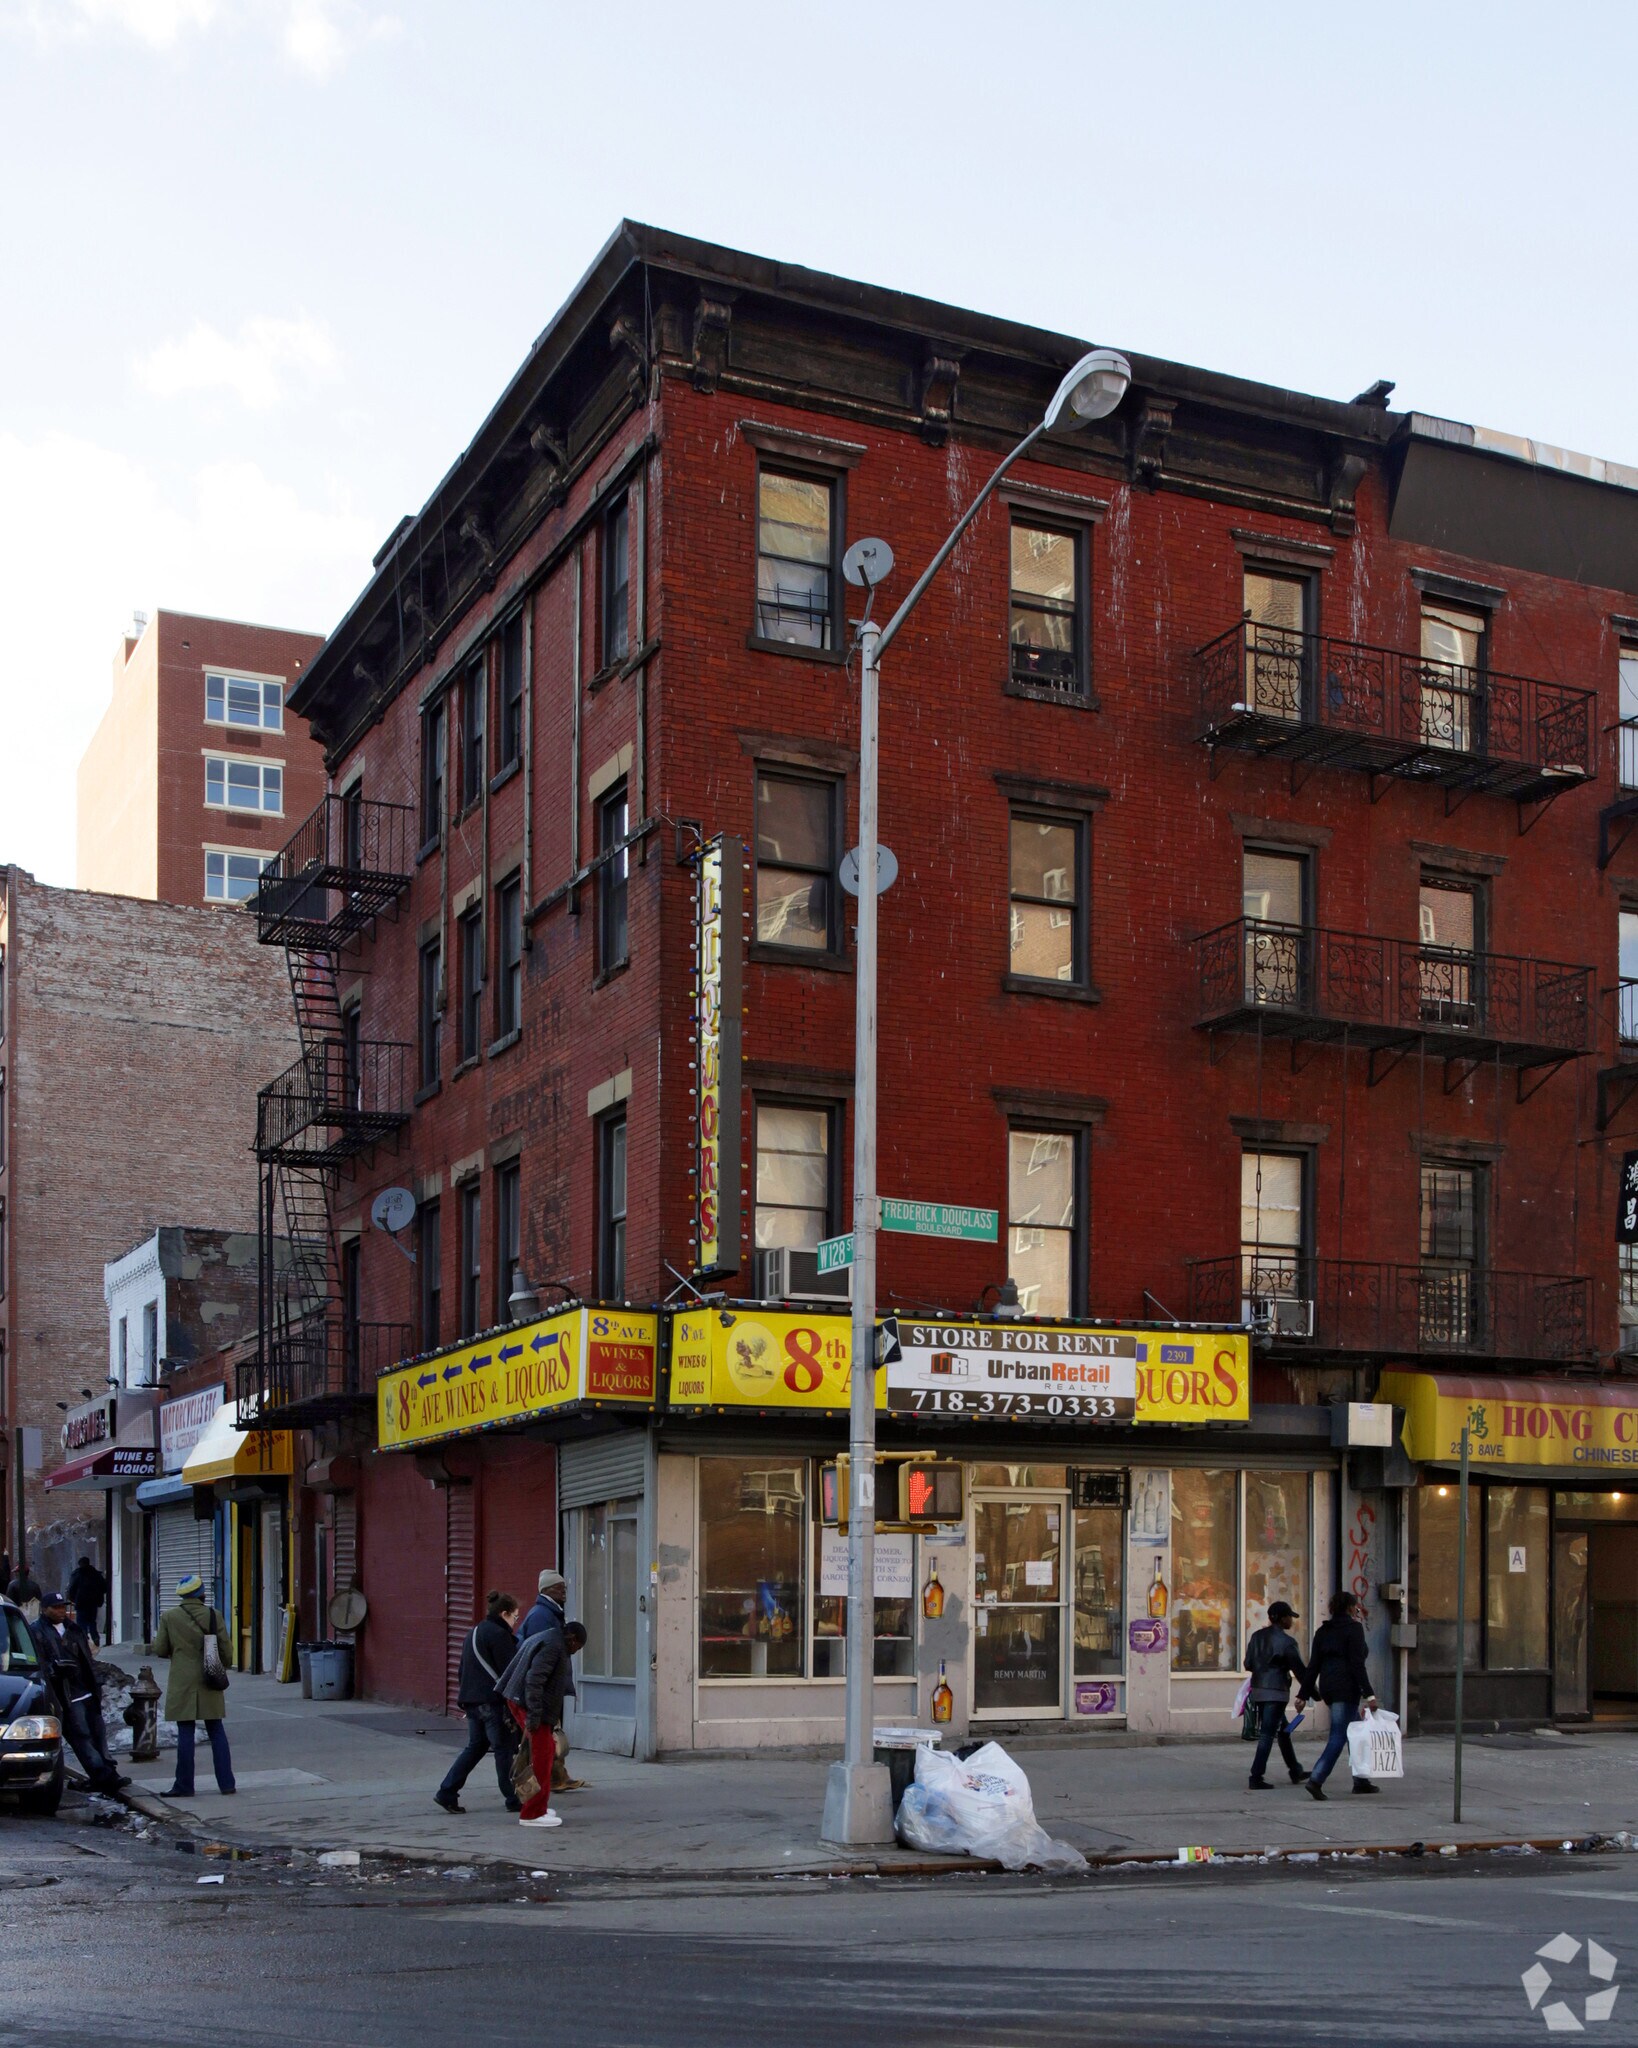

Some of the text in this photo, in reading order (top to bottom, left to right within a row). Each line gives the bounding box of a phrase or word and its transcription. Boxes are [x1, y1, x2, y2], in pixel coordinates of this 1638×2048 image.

[701, 876, 719, 1243] LIQUORS
[885, 1202, 992, 1229] FREDERICK DOUGLASS
[916, 1222, 963, 1236] BOULEVARD
[618, 1327, 651, 1340] AVE.
[912, 1326, 993, 1349] STORE
[1001, 1331, 1050, 1351] FOR
[1057, 1334, 1119, 1355] RENT
[600, 1346, 645, 1360] WINES
[1166, 1349, 1188, 1362] 2391
[615, 1362, 627, 1372] &
[678, 1355, 701, 1368] WINES
[445, 1379, 486, 1420] WINES
[490, 1381, 499, 1404] &
[505, 1330, 572, 1408] LIQUORS
[592, 1372, 650, 1391] LIQUORS
[678, 1381, 705, 1397] LIQUORS
[1044, 1382, 1110, 1393] REALTY
[910, 1390, 1115, 1416] 718-373-0333
[1501, 1405, 1593, 1441] HONG
[1450, 1442, 1474, 1456] 233
[113, 1451, 155, 1462] WINE &
[113, 1464, 155, 1474] LIQUOR
[1511, 1550, 1523, 1565] A
[1017, 1669, 1047, 1680] MARTIN
[1372, 1751, 1397, 1771] JAZZ
